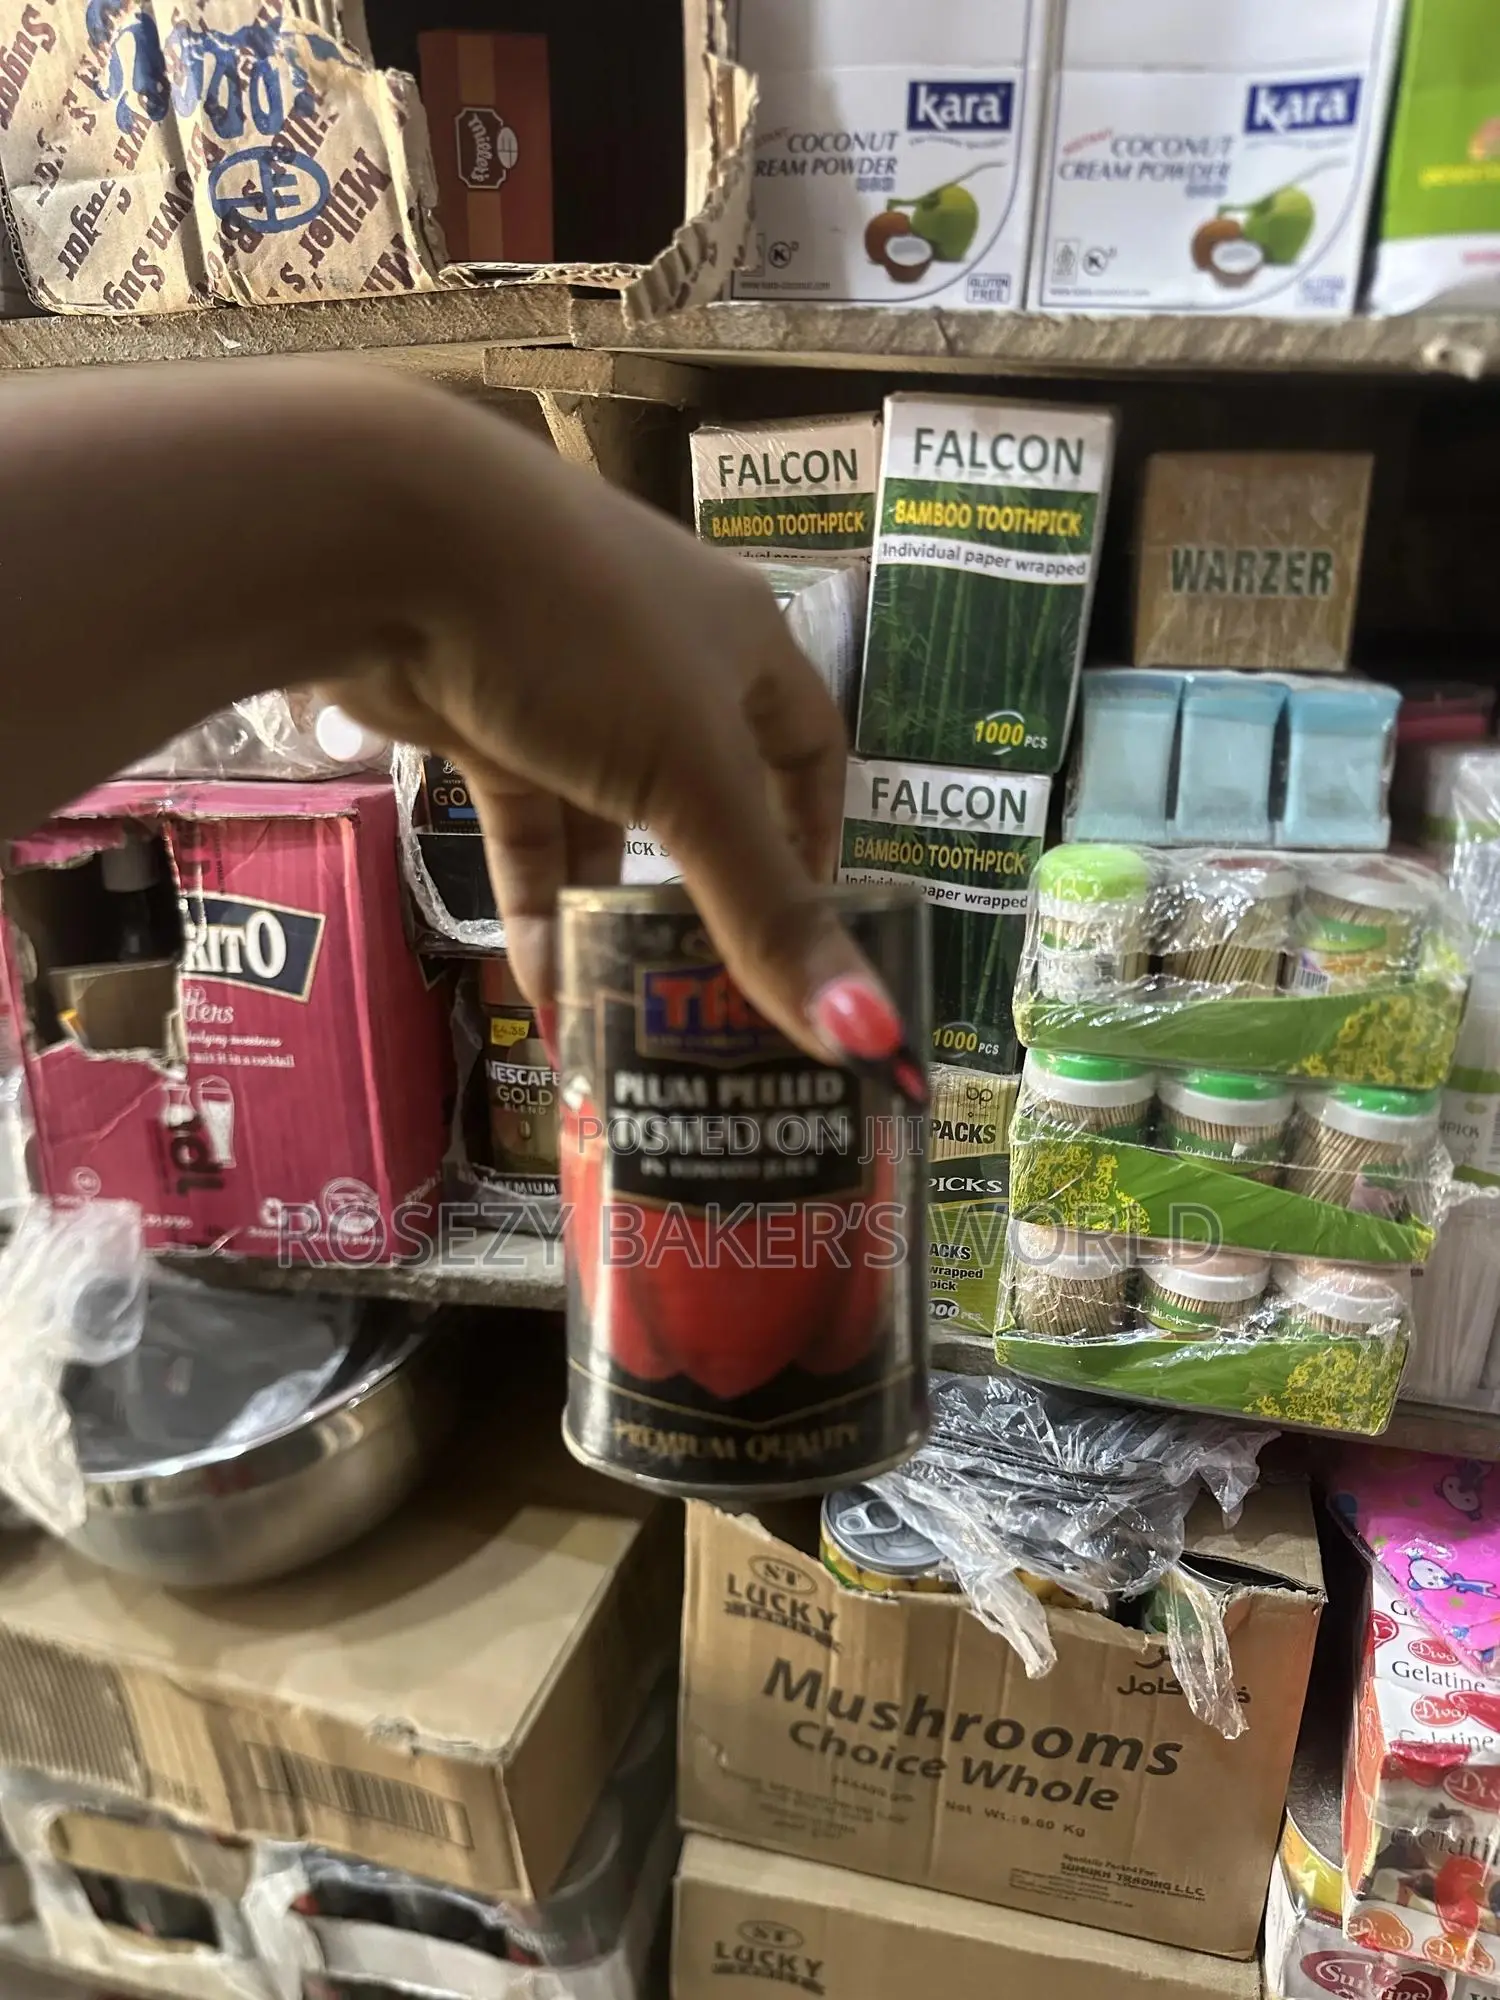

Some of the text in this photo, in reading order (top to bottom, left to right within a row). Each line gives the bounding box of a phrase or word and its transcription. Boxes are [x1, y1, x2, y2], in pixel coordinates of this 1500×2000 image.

[916, 84, 1001, 130] kara
[1254, 90, 1347, 133] kara
[788, 131, 899, 153] COCONUT
[1110, 135, 1234, 156] COCONUT
[811, 157, 898, 176] POWDER
[1059, 161, 1232, 182] CREAM POWDER
[279, 147, 392, 294] Miller's
[718, 448, 858, 488] FALCON
[914, 427, 1085, 476] FALCON
[712, 510, 865, 537] BAMBOO TOOTHPICK
[895, 499, 1083, 537] BAMBOO TOOTHPICK
[882, 542, 960, 562] Individual
[964, 551, 1012, 570] paper
[1014, 561, 1087, 580] wrapped
[1171, 549, 1333, 595] WARZER
[975, 720, 1048, 750] 1000 PCS
[871, 776, 1028, 824] FALCON
[854, 837, 1027, 875] BAMBOO TOOTHPICK
[964, 891, 1028, 910] wrapped
[932, 1025, 1000, 1056] 1000 PCS
[497, 1084, 554, 1106] GOLD
[930, 1118, 997, 1144] PACKS
[727, 1572, 838, 1632] LUCKY
[1391, 1660, 1486, 1693] Gelatine
[763, 1656, 1184, 1776] Mushrooms
[789, 1719, 948, 1779] Choice
[961, 1755, 1121, 1812] Whole
